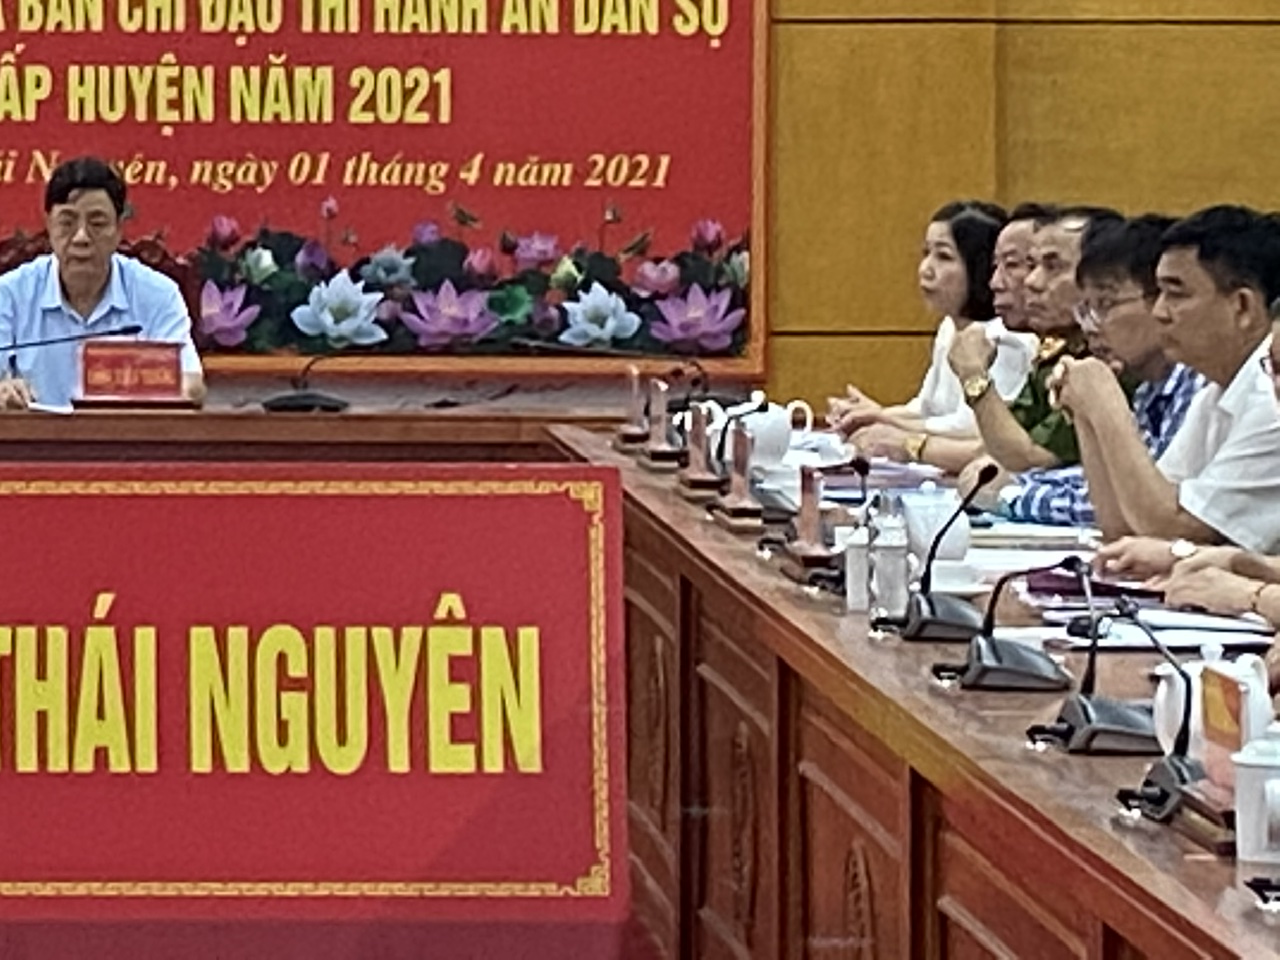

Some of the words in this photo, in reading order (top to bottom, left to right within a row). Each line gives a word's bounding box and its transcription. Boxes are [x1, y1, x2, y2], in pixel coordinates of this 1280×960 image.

[67, 52, 215, 136] HUYỆN
[229, 54, 334, 124] NĂM
[348, 66, 451, 124] 2021
[25, 149, 179, 191] Nên,
[190, 153, 279, 194] ngày
[288, 152, 332, 185] 01
[343, 151, 449, 193] tháng
[459, 152, 484, 186] 4
[493, 156, 573, 187] năm
[584, 153, 671, 188] 2021
[189, 593, 543, 776] NGUYÊN
